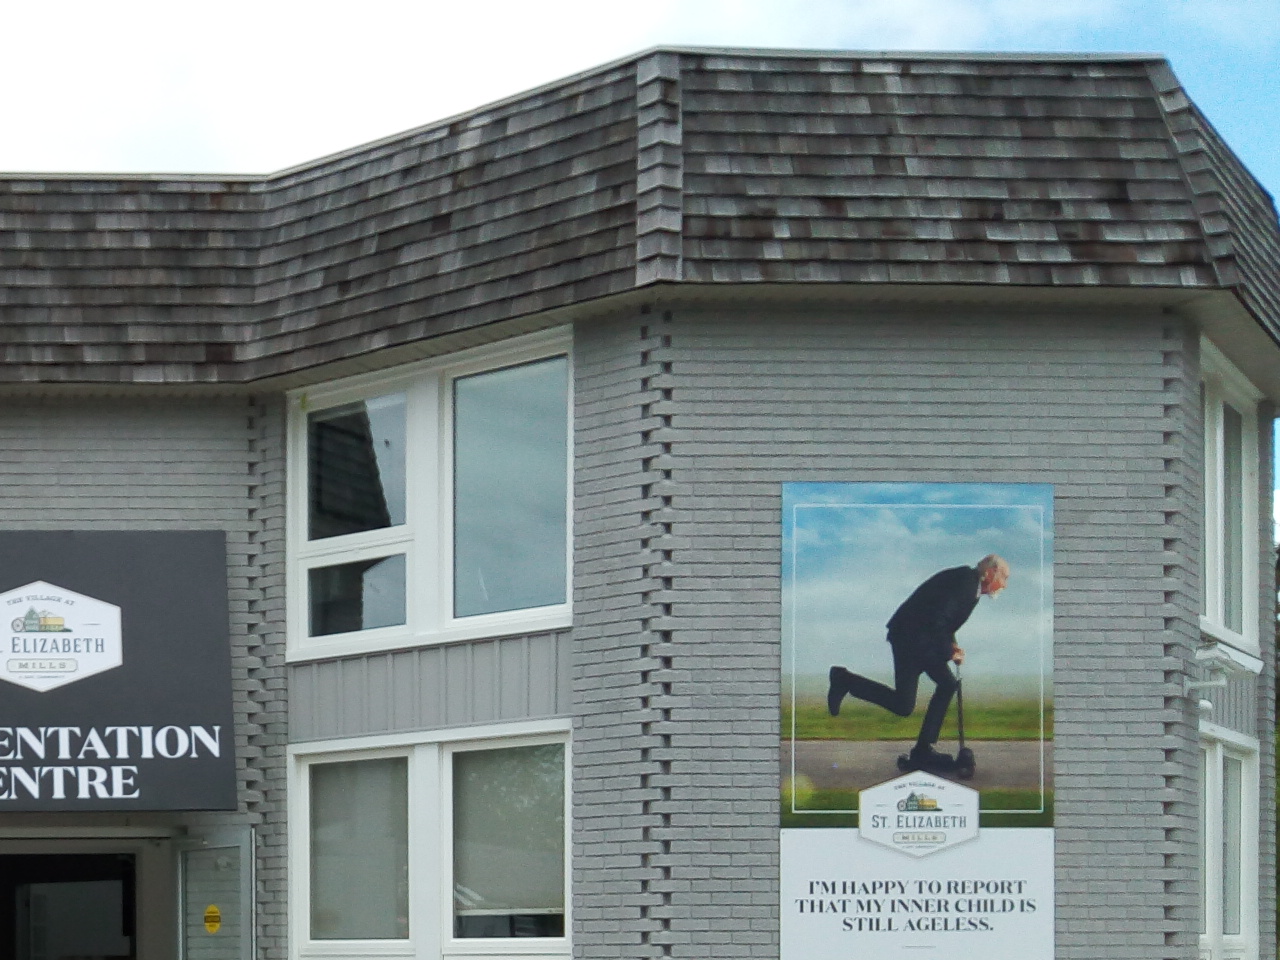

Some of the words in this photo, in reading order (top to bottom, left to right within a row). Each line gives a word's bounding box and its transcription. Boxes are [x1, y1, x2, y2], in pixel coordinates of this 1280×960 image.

[26, 594, 63, 603] VILLAGE
[11, 636, 106, 654] ELIZABETH
[871, 814, 891, 829] ST.
[896, 814, 967, 829] ELIZABETH
[808, 880, 837, 895] I'M
[841, 880, 910, 895] HAPPY
[913, 880, 942, 895] TO
[946, 880, 1027, 895] REPORT
[795, 898, 852, 914] THAT
[855, 898, 888, 914] MY
[890, 898, 950, 914] INNER
[954, 898, 1016, 914] CHILD
[1019, 898, 1037, 914] IS
[842, 917, 899, 932] STILL
[903, 917, 994, 932] AGELESS.
